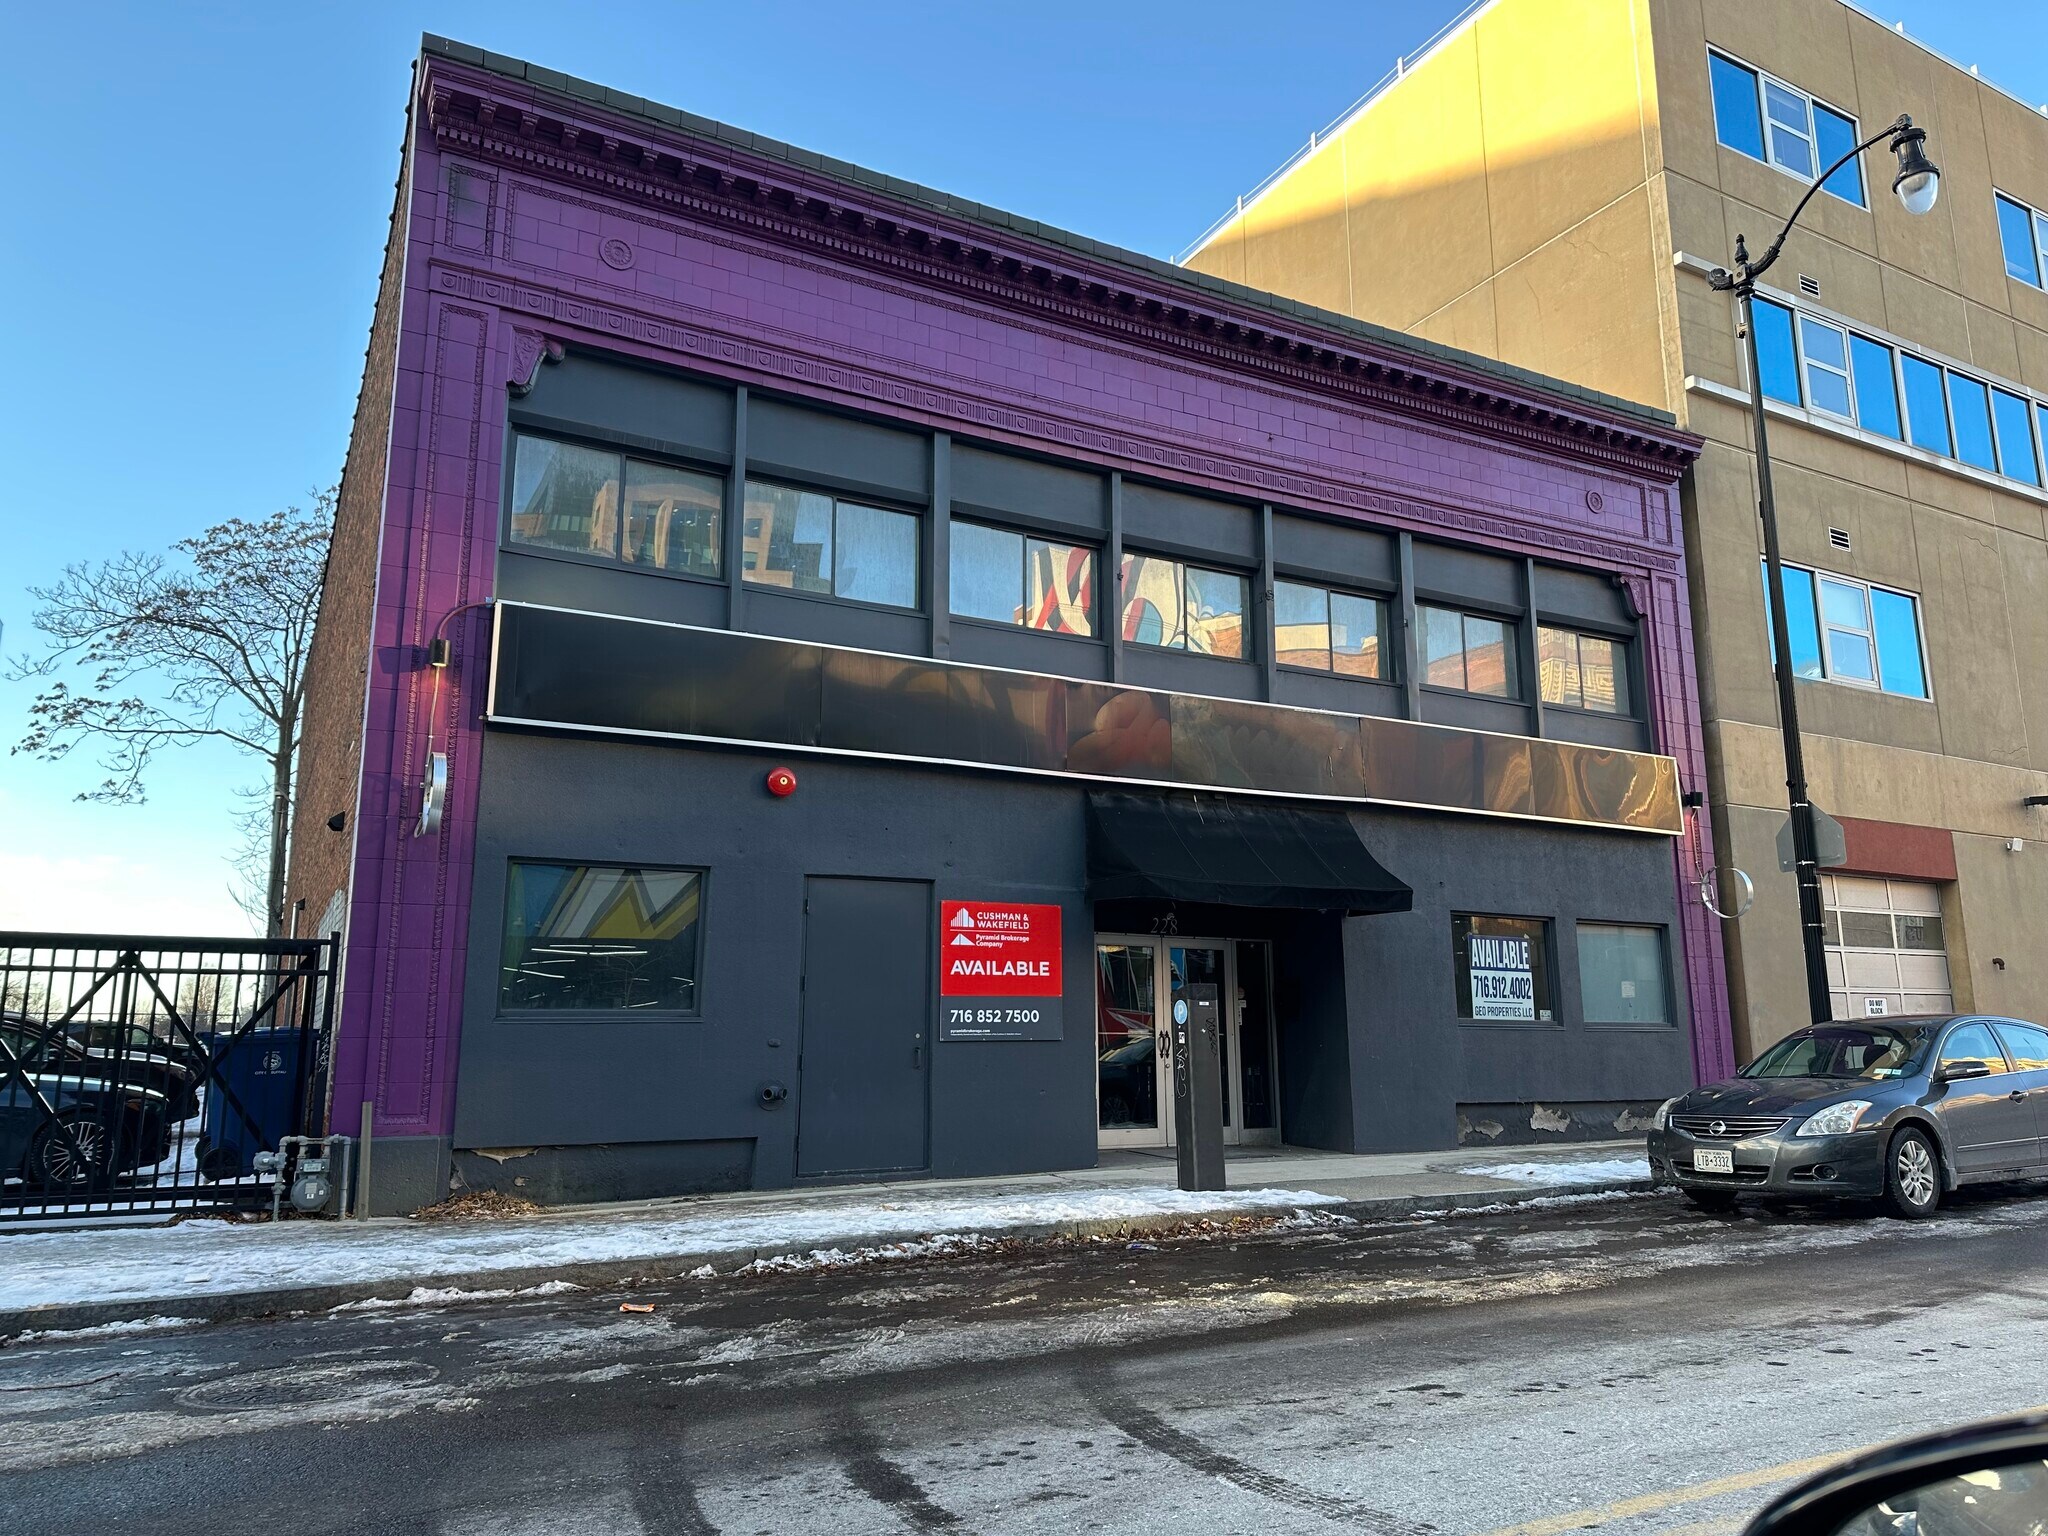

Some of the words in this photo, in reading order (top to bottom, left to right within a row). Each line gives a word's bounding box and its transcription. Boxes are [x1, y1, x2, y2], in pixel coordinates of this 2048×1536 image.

[977, 912, 1020, 921] CUSHMAN
[1023, 913, 1029, 921] &
[977, 920, 1030, 929] WAKEFIELD
[1150, 917, 1178, 935] 228
[976, 940, 1003, 948] Company
[1001, 935, 1030, 943] Brokerage
[1472, 938, 1530, 969] AVAILABLE
[950, 960, 1050, 976] AVAILABLE
[1473, 975, 1532, 999] 716.912.4002
[950, 1009, 973, 1023] 716
[977, 1009, 1002, 1023] 852
[1005, 1009, 1040, 1023] 7500
[1475, 1006, 1487, 1017] GEO
[1487, 1006, 1521, 1017] PROPERTIES
[1522, 1007, 1533, 1018] LLC
